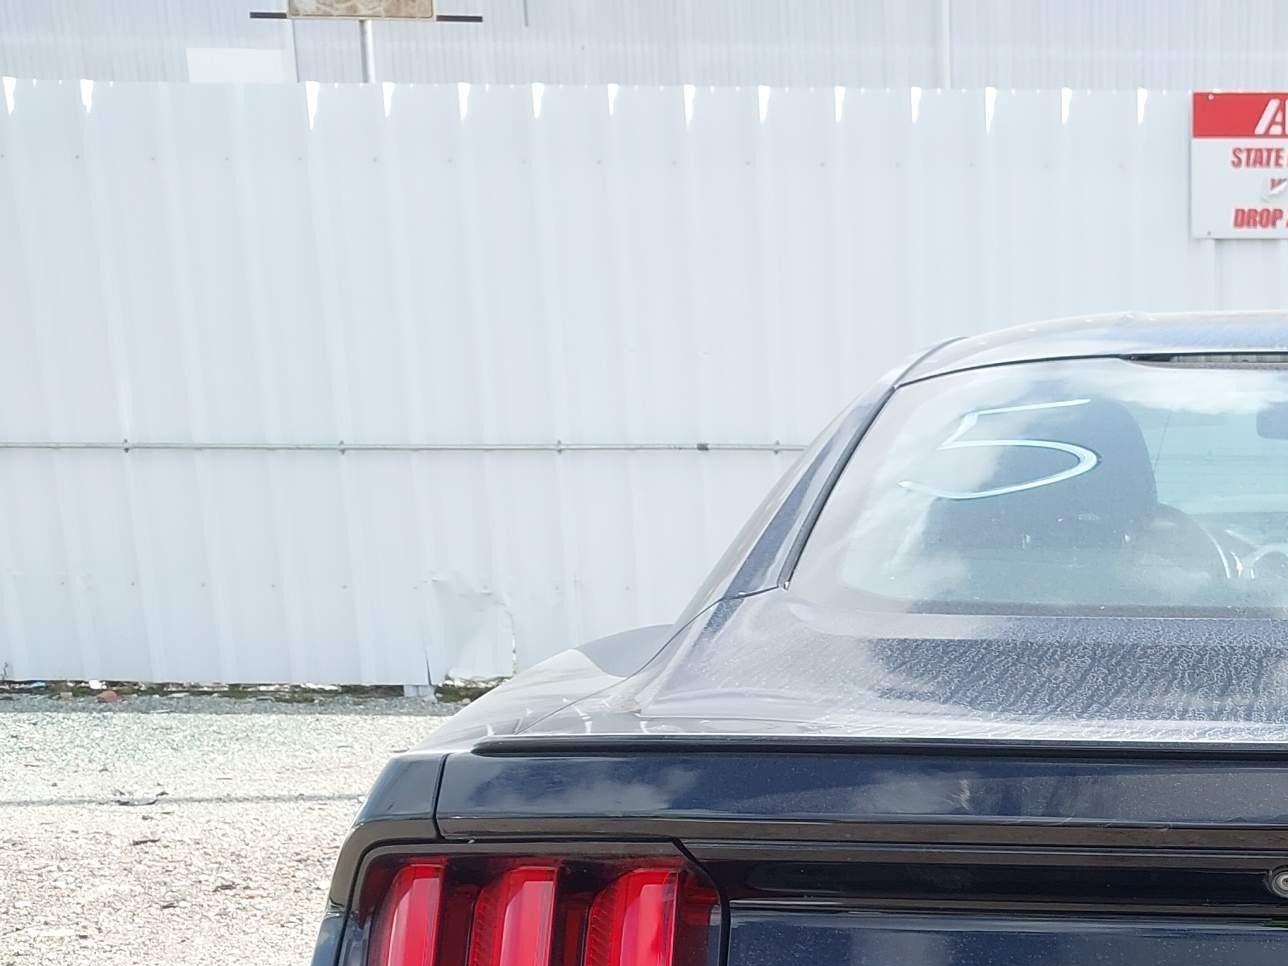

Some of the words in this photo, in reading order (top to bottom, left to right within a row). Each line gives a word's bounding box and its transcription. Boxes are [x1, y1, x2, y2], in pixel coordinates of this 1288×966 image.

[1231, 146, 1284, 168] STATE
[1233, 207, 1283, 229] DROP
[898, 398, 1099, 500] 5
